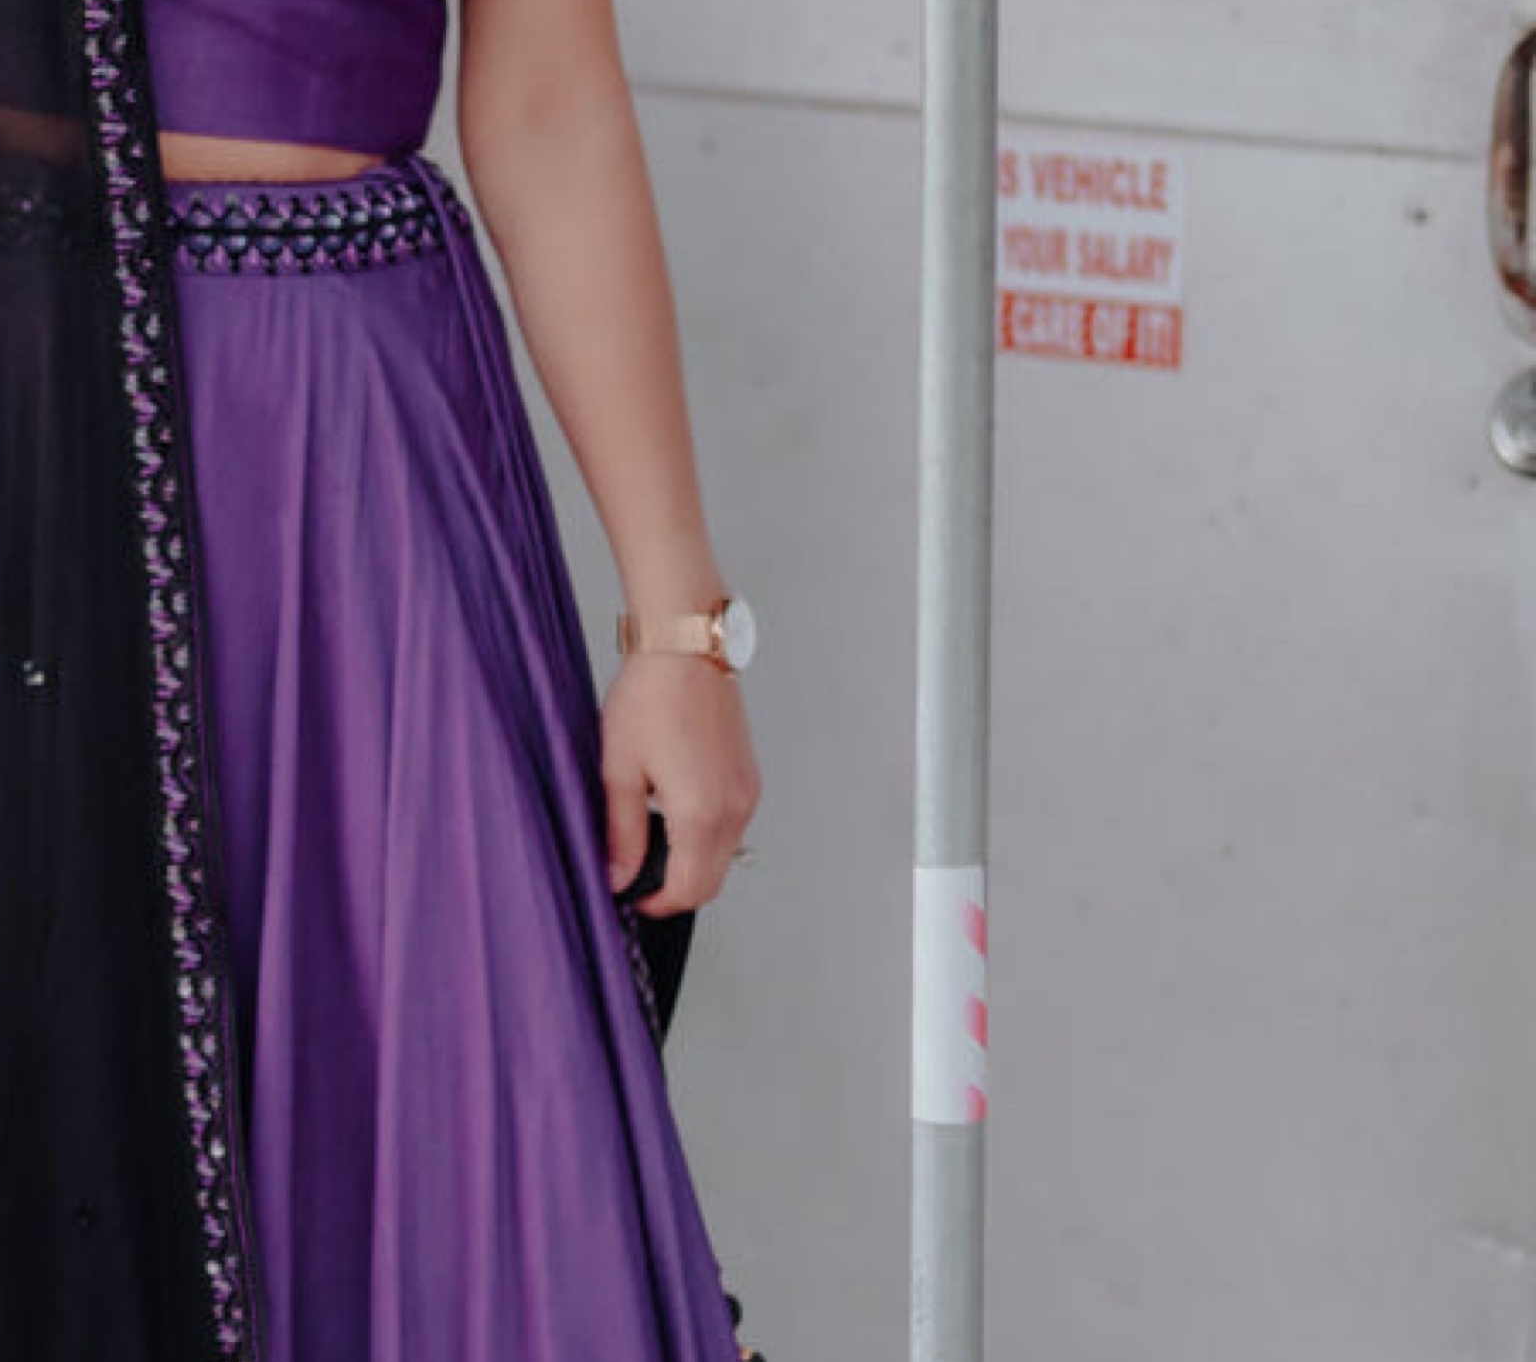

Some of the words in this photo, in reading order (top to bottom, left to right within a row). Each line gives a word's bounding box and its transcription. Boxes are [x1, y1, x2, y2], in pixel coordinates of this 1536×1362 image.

[1030, 153, 1169, 212] VEHICLE
[1004, 225, 1068, 275] YOUR
[1077, 230, 1174, 284] SALARY
